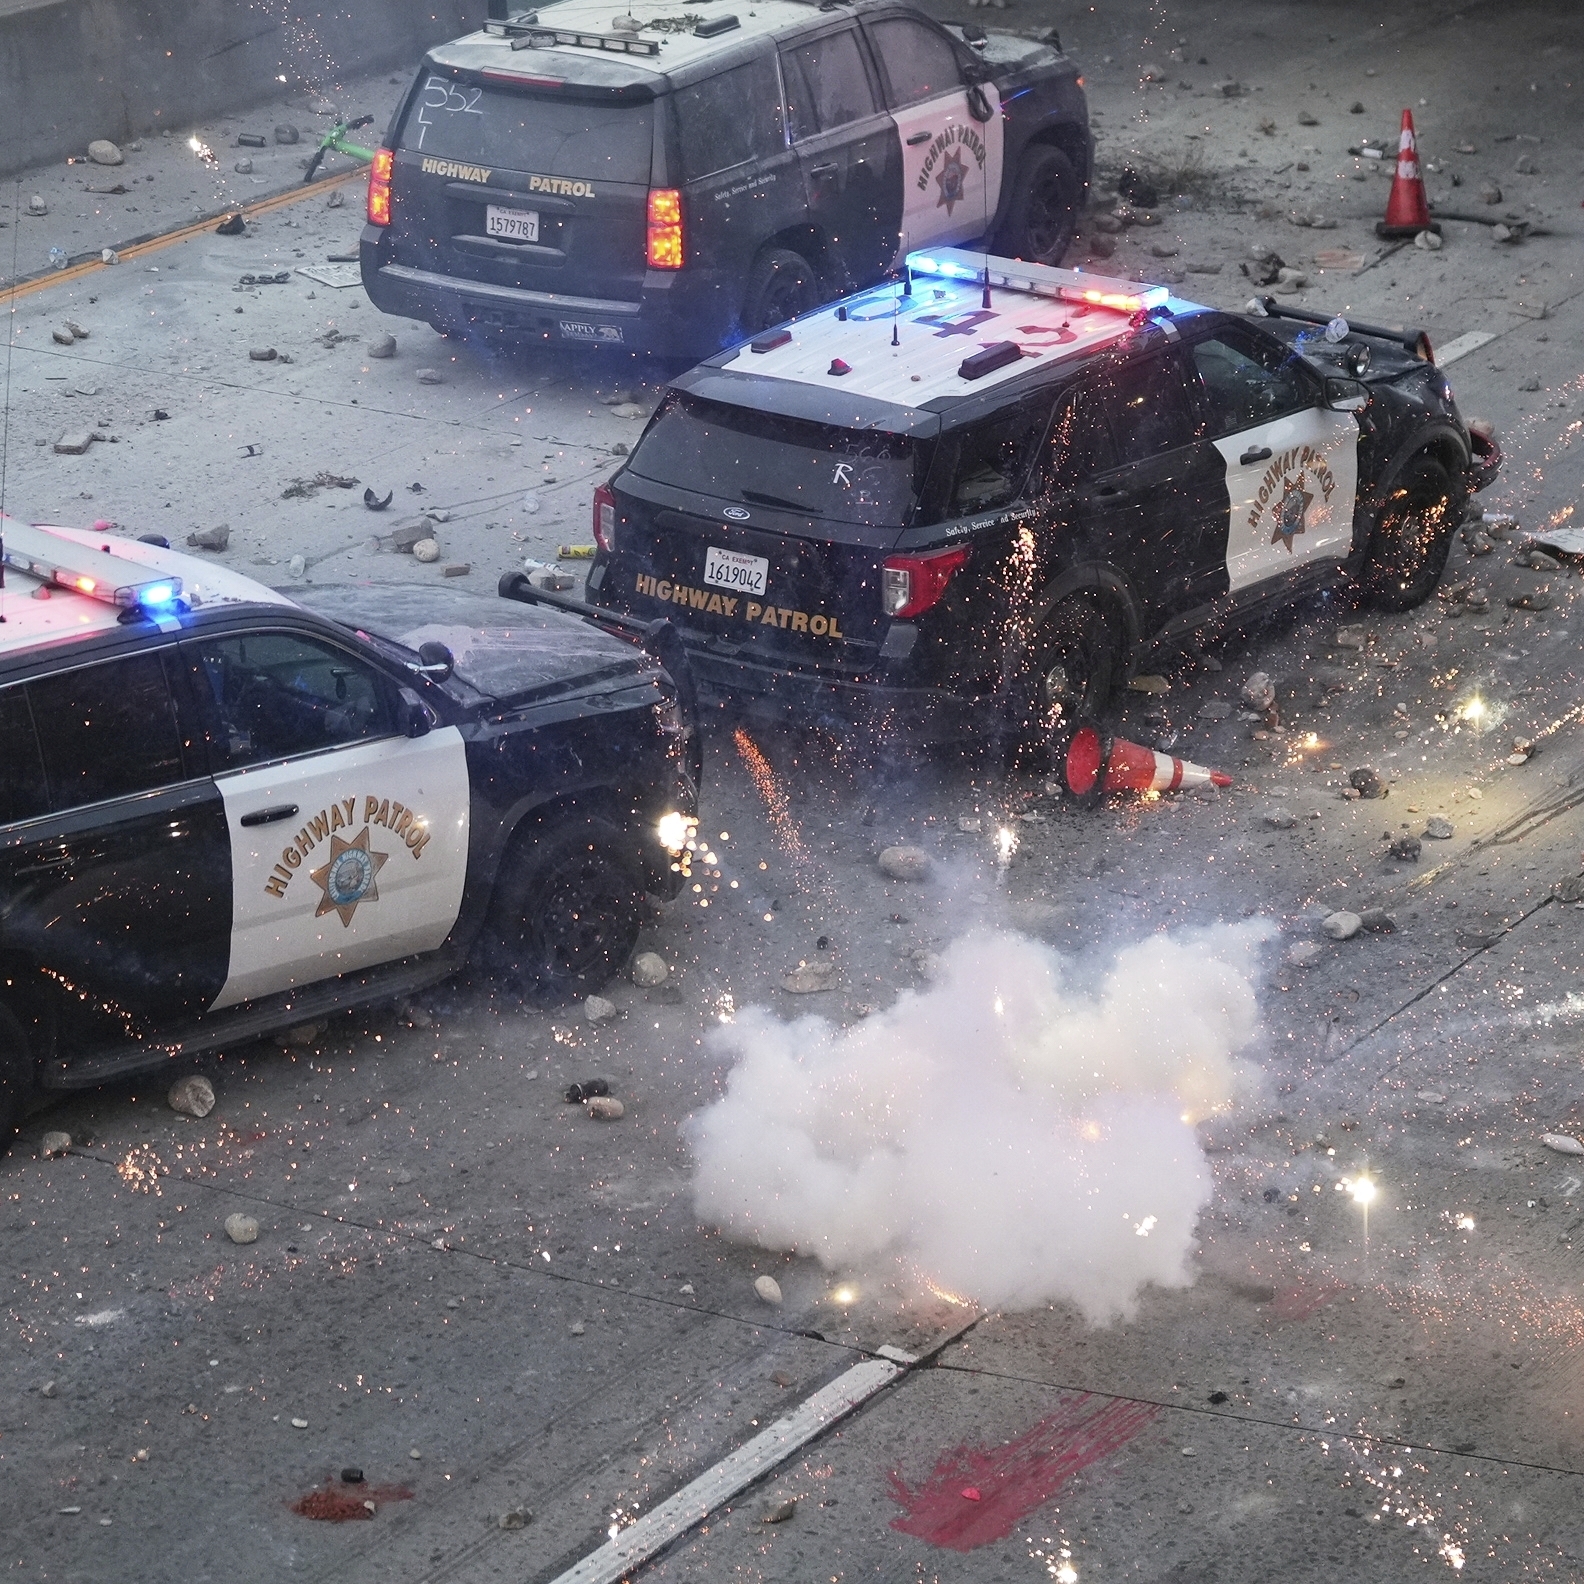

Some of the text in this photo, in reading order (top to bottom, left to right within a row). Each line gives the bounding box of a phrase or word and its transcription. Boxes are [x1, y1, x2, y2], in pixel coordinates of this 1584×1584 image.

[424, 76, 484, 115] 552
[917, 123, 987, 191] HIGHWAY PATROL
[422, 158, 596, 198] HIGHWAY PATROL
[490, 216, 535, 237] 1579787
[564, 323, 596, 334] APPLY
[832, 462, 854, 485] R
[1245, 445, 1336, 528] HIGHWAY PATROL
[727, 508, 746, 518] Ford
[945, 524, 971, 537] Safety,
[971, 518, 996, 531] Service
[707, 562, 762, 590] 1619042
[635, 572, 844, 639] HIGHWAY PATROL
[265, 796, 431, 898] HIGHWAY PATROL
